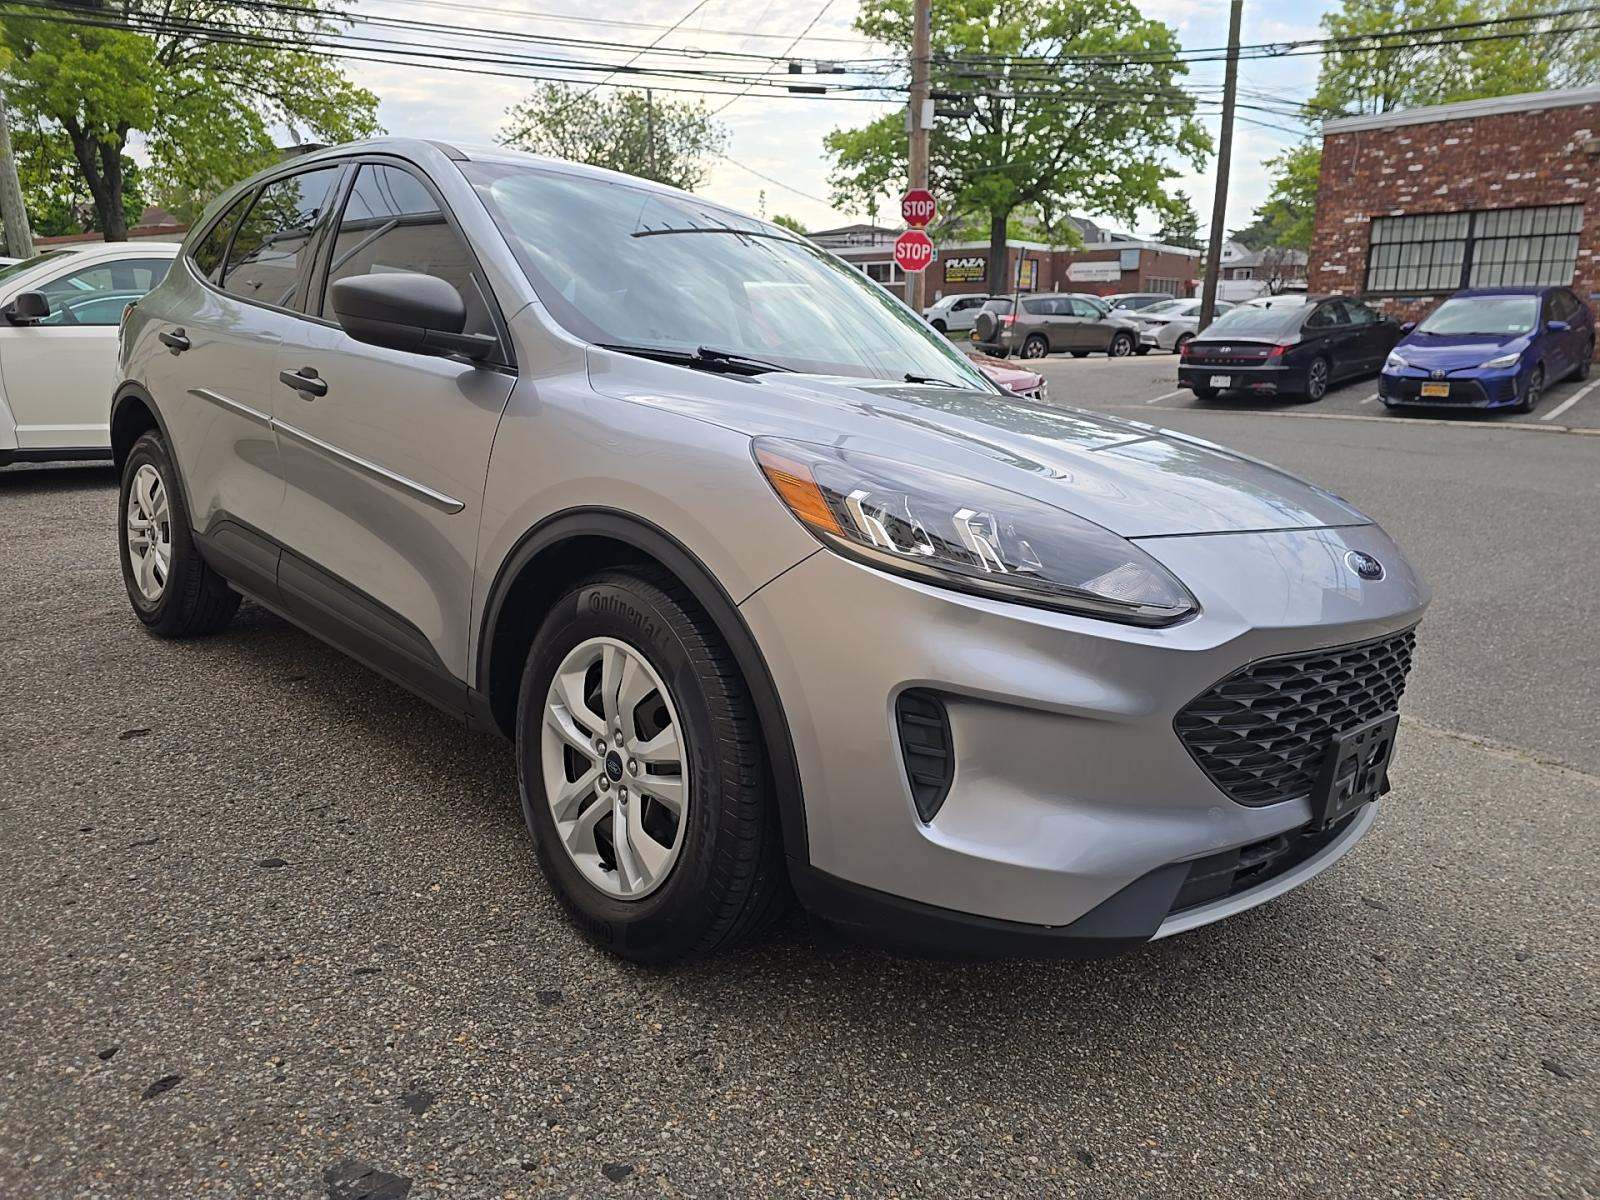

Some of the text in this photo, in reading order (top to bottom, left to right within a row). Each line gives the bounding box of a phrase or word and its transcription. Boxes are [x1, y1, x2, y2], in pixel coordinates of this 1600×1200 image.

[903, 200, 934, 217] STOP
[896, 242, 931, 260] STOP
[945, 257, 986, 268] PLAZA
[589, 591, 662, 640] Continental
